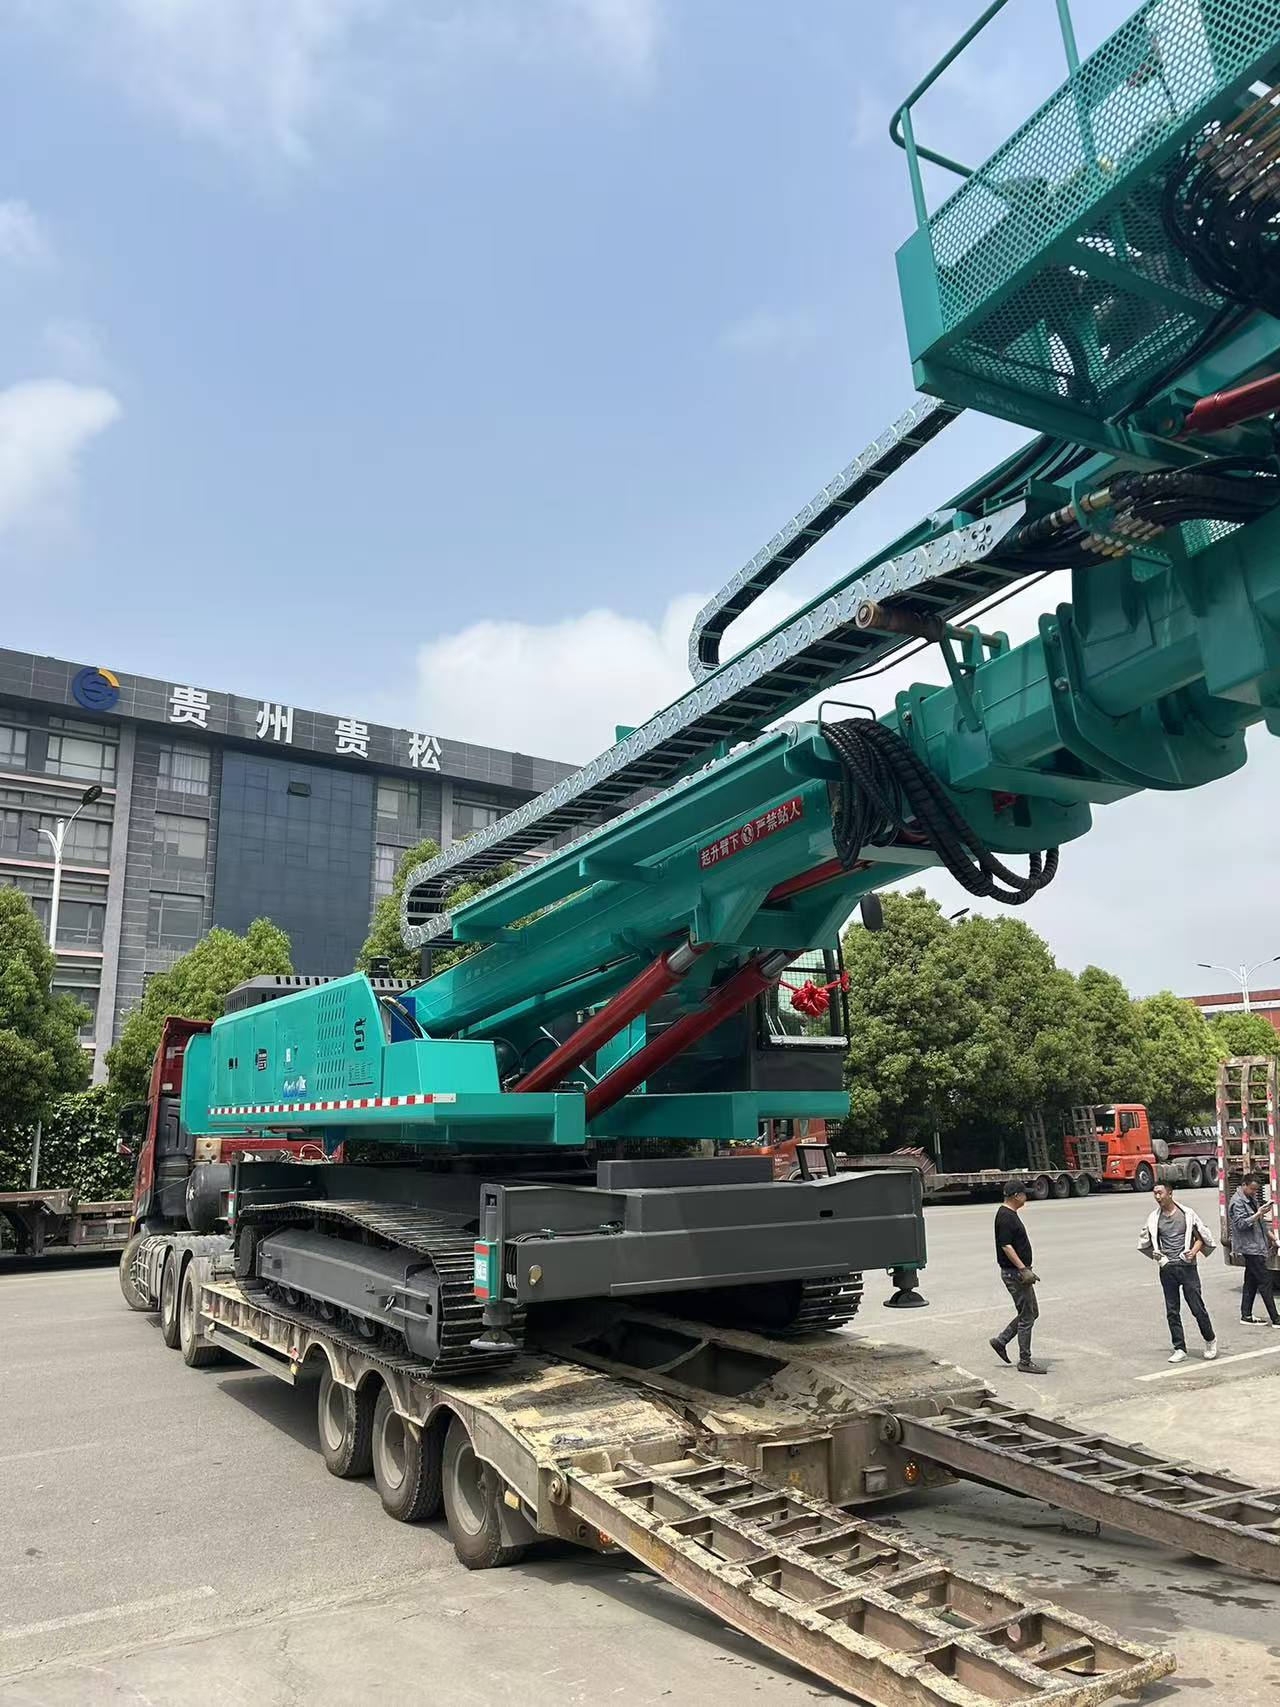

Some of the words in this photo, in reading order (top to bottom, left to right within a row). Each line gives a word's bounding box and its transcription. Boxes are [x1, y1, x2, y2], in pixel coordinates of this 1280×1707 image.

[169, 686, 442, 772] 贵州贵松
[701, 833, 739, 867] 起升臂下
[756, 801, 801, 838] 严禁站人
